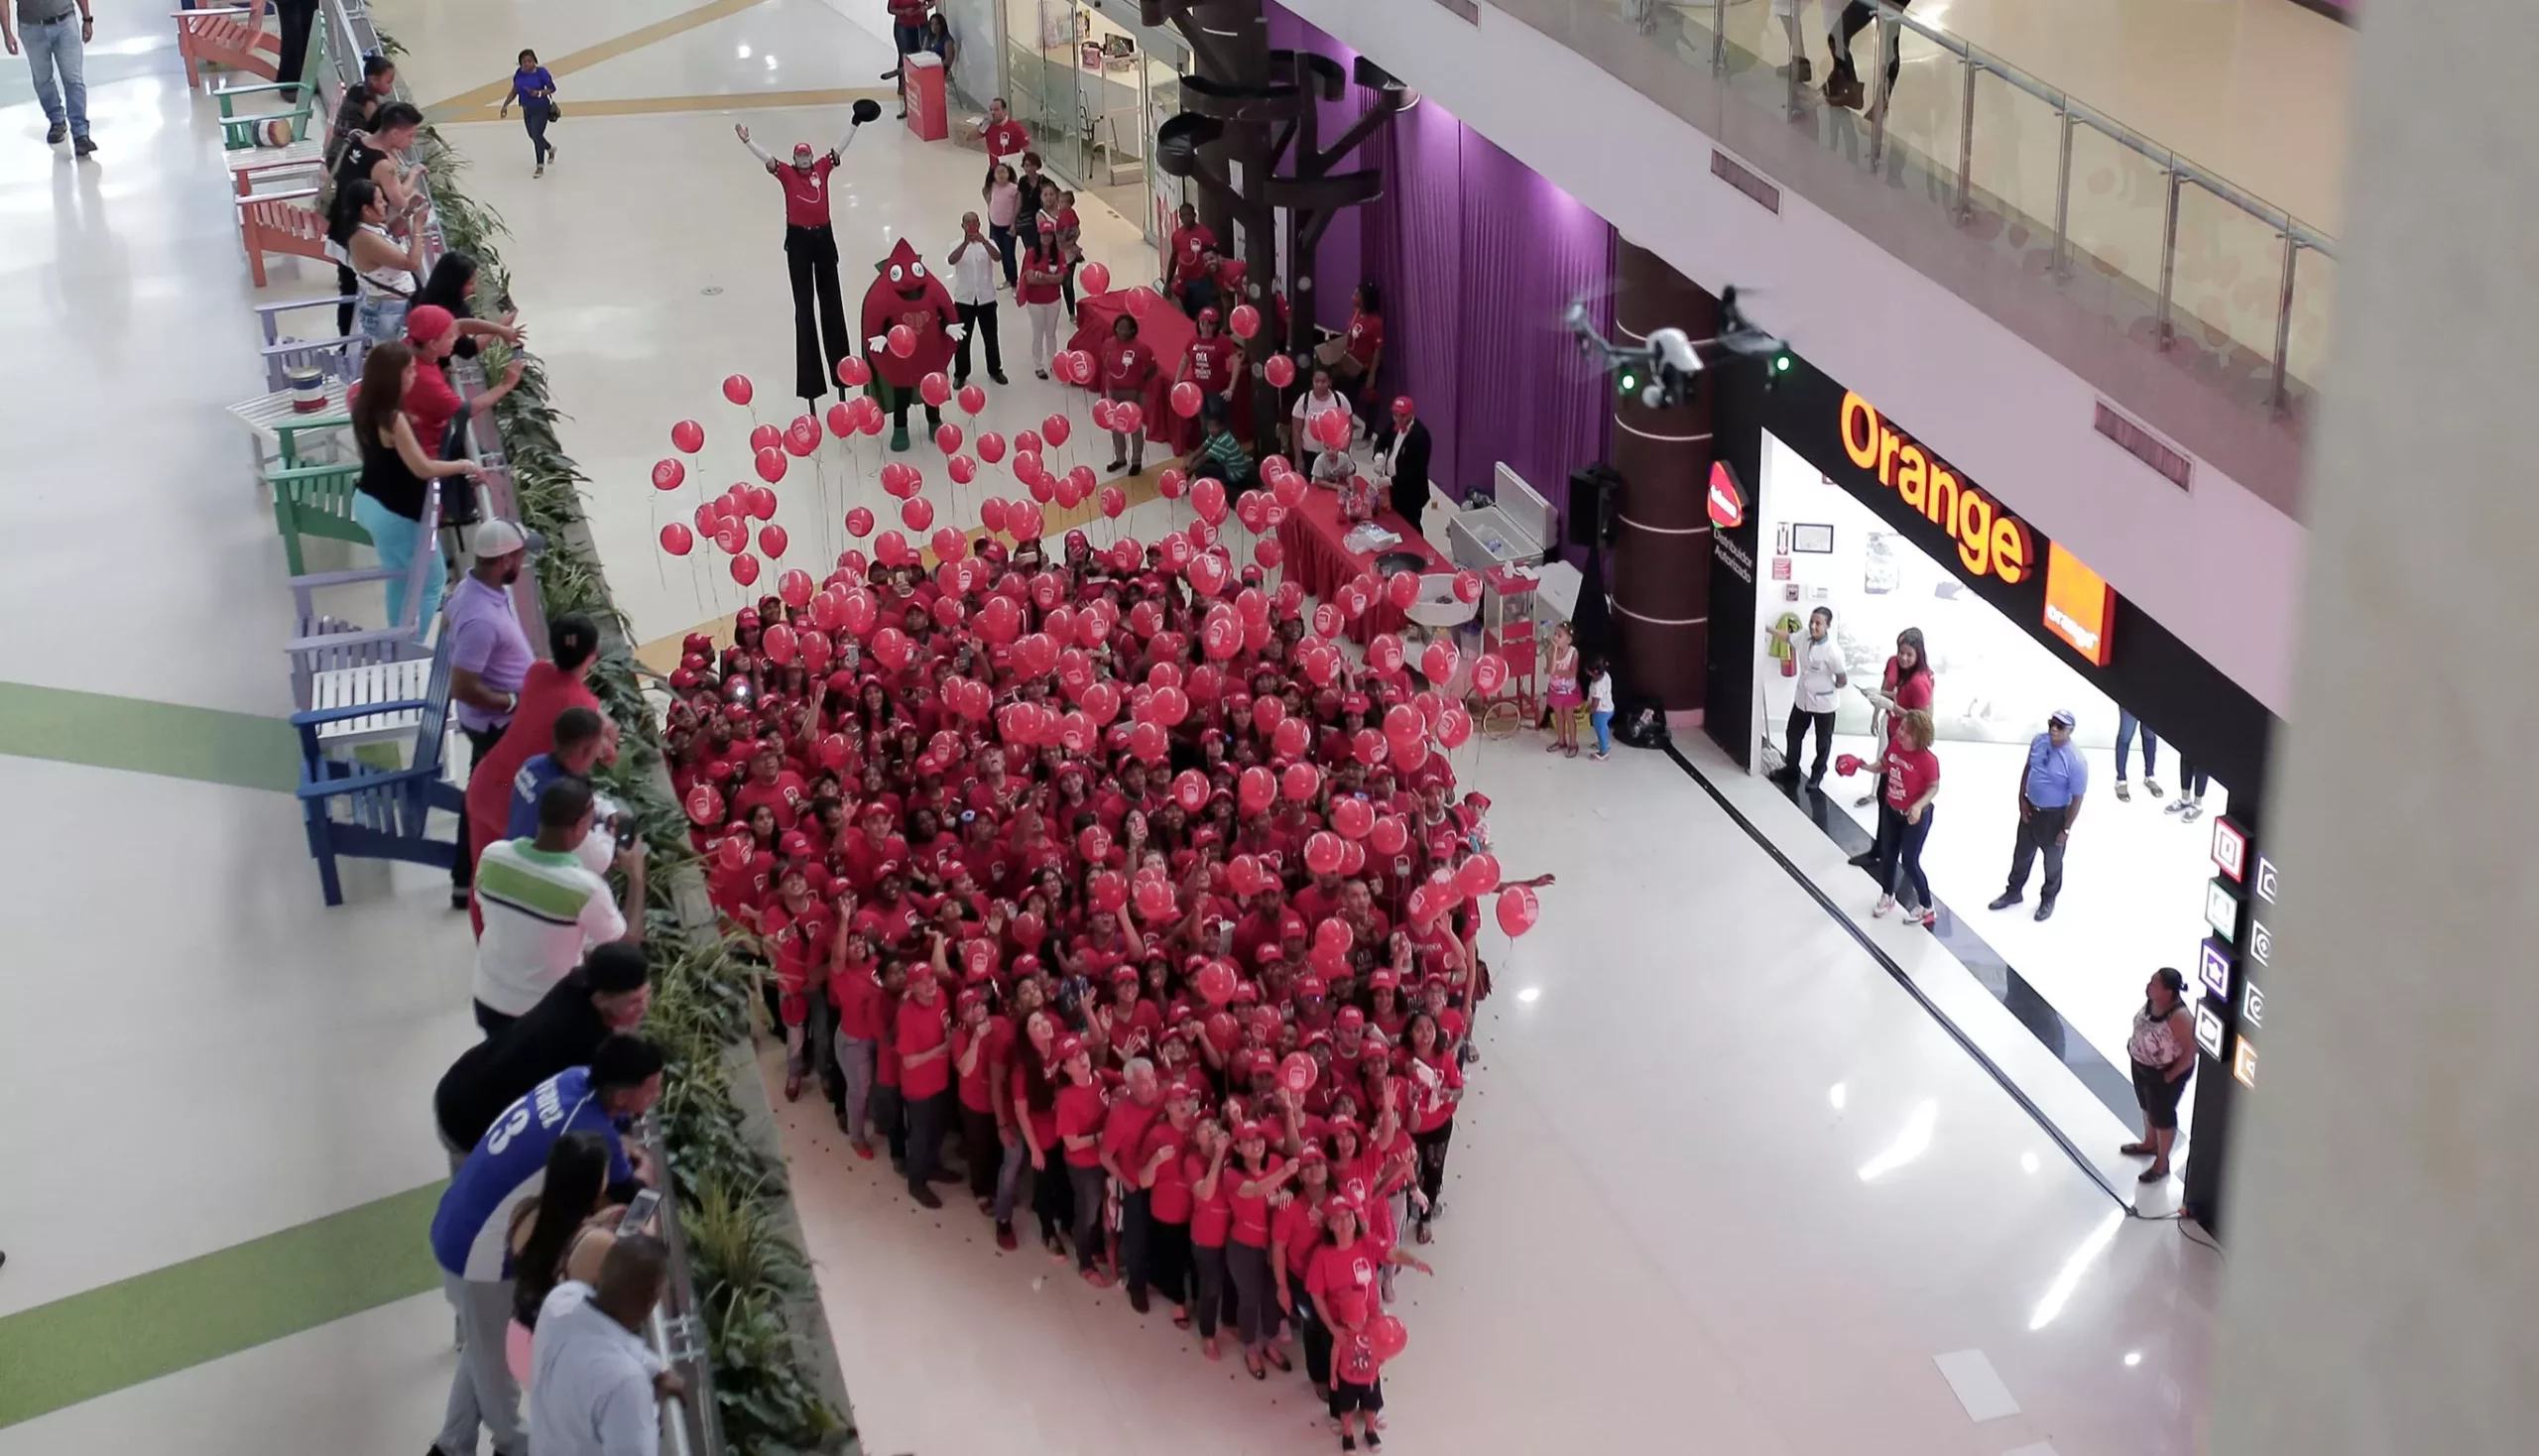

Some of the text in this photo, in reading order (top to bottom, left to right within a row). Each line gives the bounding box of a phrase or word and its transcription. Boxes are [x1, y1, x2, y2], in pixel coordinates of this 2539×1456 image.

[1841, 389, 2024, 584] Orange
[1713, 528, 1753, 568] Distribuidor
[1714, 545, 1752, 583] Autorizado
